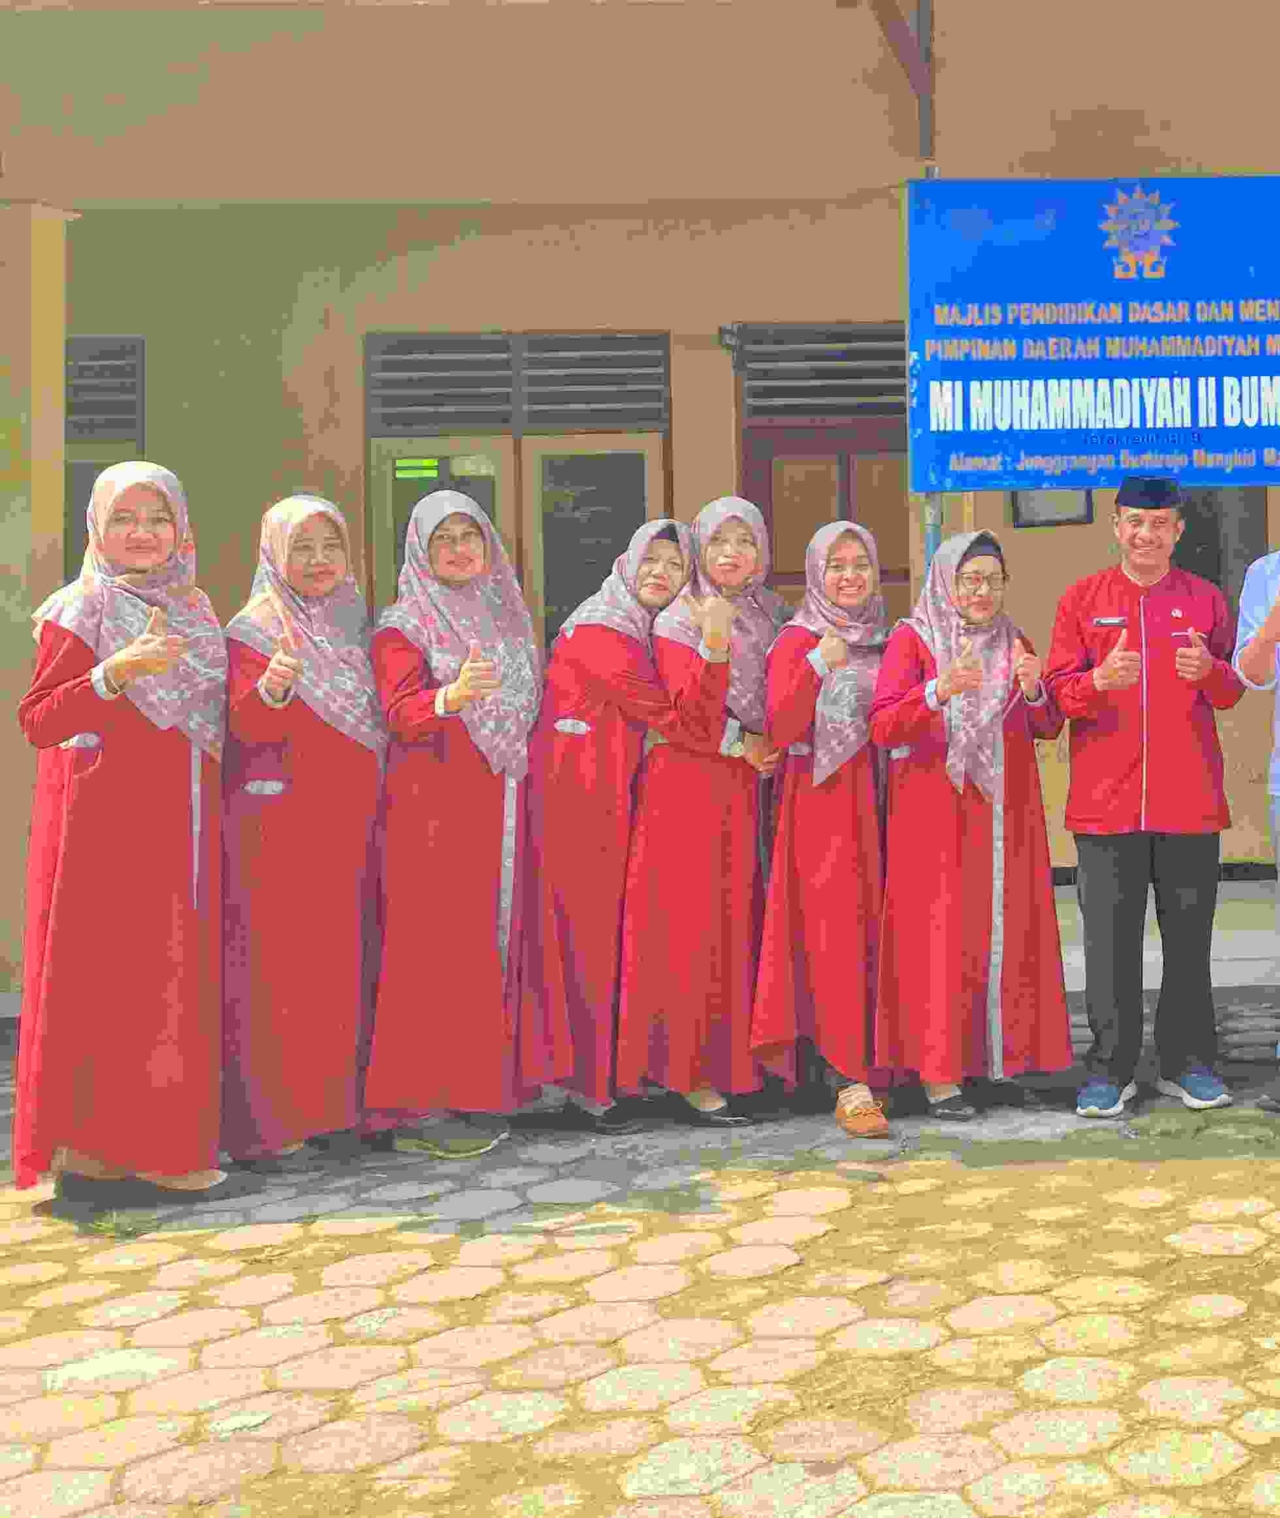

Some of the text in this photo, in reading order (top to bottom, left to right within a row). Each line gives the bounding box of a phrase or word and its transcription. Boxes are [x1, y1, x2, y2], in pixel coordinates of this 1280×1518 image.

[934, 303, 1002, 325] MAJLIS
[1008, 302, 1122, 324] PENDIDIKAN
[1129, 301, 1191, 323] DASAR
[1197, 301, 1234, 322] DAN
[925, 339, 1016, 361] PIMPINAN
[1023, 338, 1100, 360] DAERAH
[1106, 336, 1260, 359] MUHAMMADIYAH
[929, 380, 963, 431] MI
[970, 377, 1191, 431] MUHAMMADIYAH
[1198, 377, 1217, 427] II
